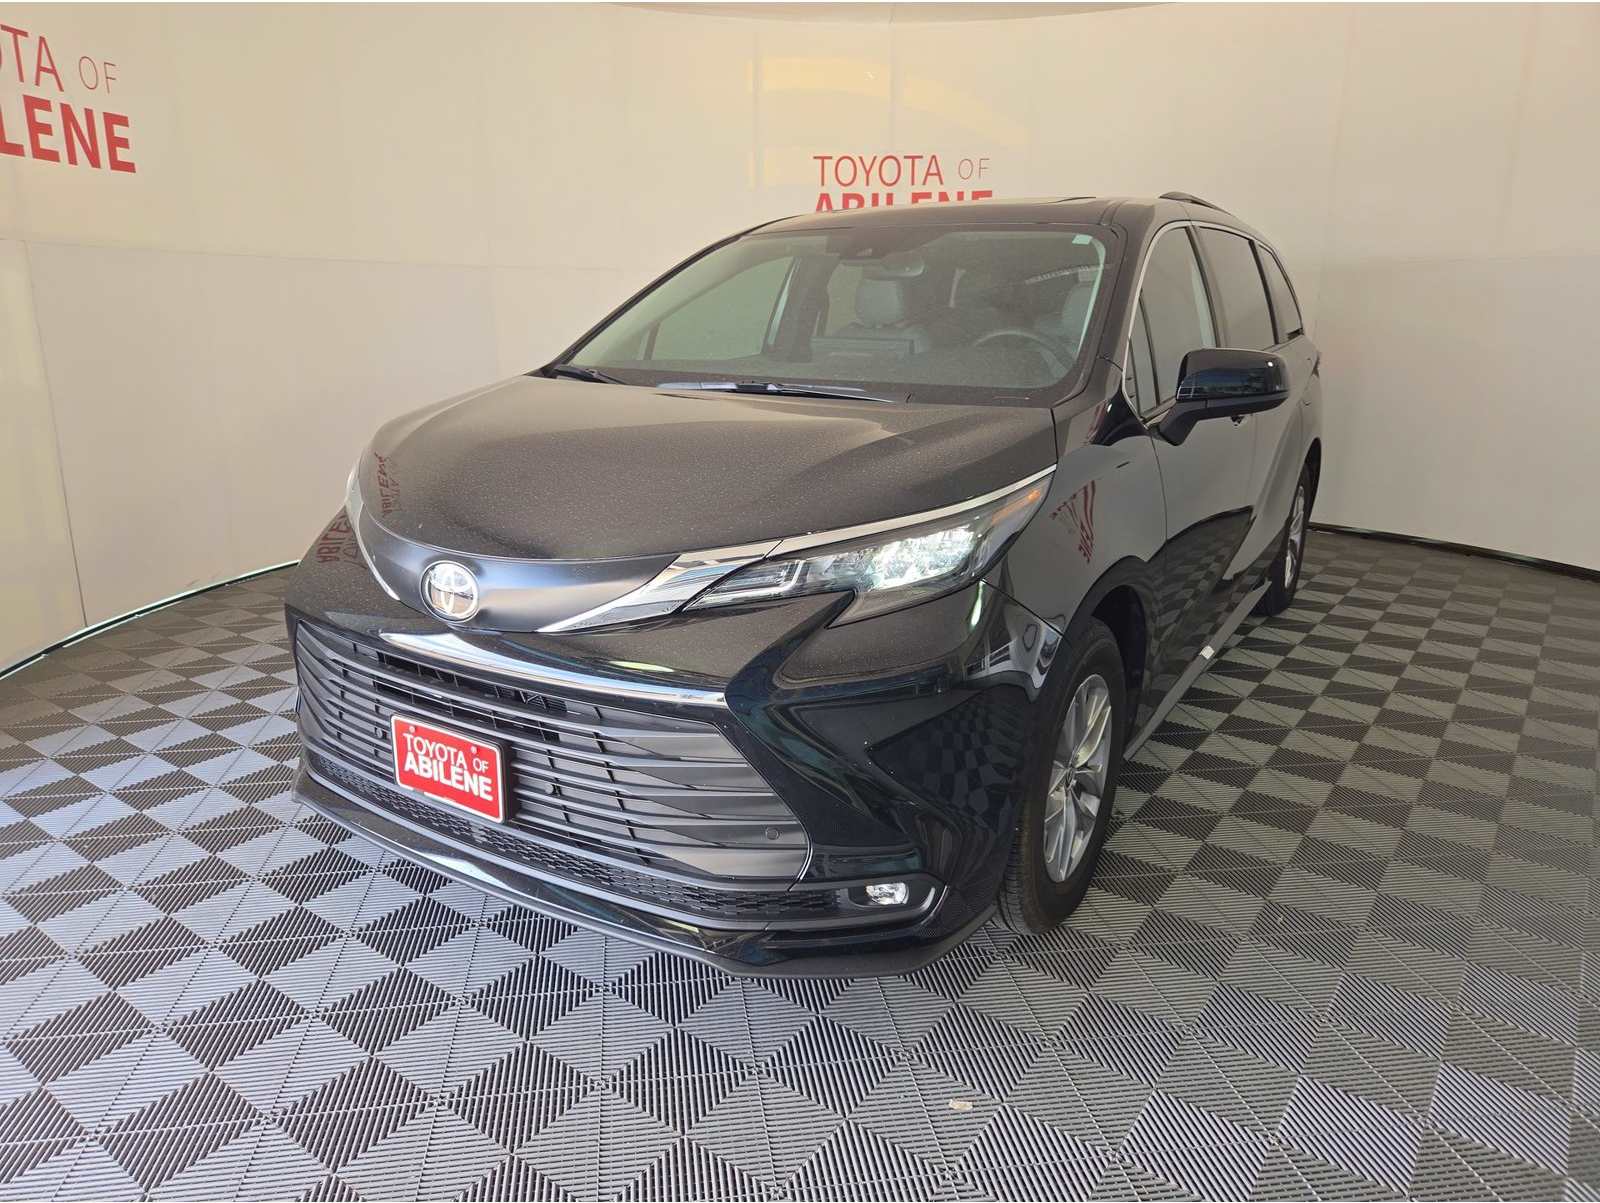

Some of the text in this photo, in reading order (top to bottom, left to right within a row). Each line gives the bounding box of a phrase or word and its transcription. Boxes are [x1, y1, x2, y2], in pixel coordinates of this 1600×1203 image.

[0, 24, 117, 94] TA OF
[813, 154, 990, 188] TOYOTA OF
[403, 733, 489, 773] TOYOTA OF
[404, 751, 493, 801] ABILENE
